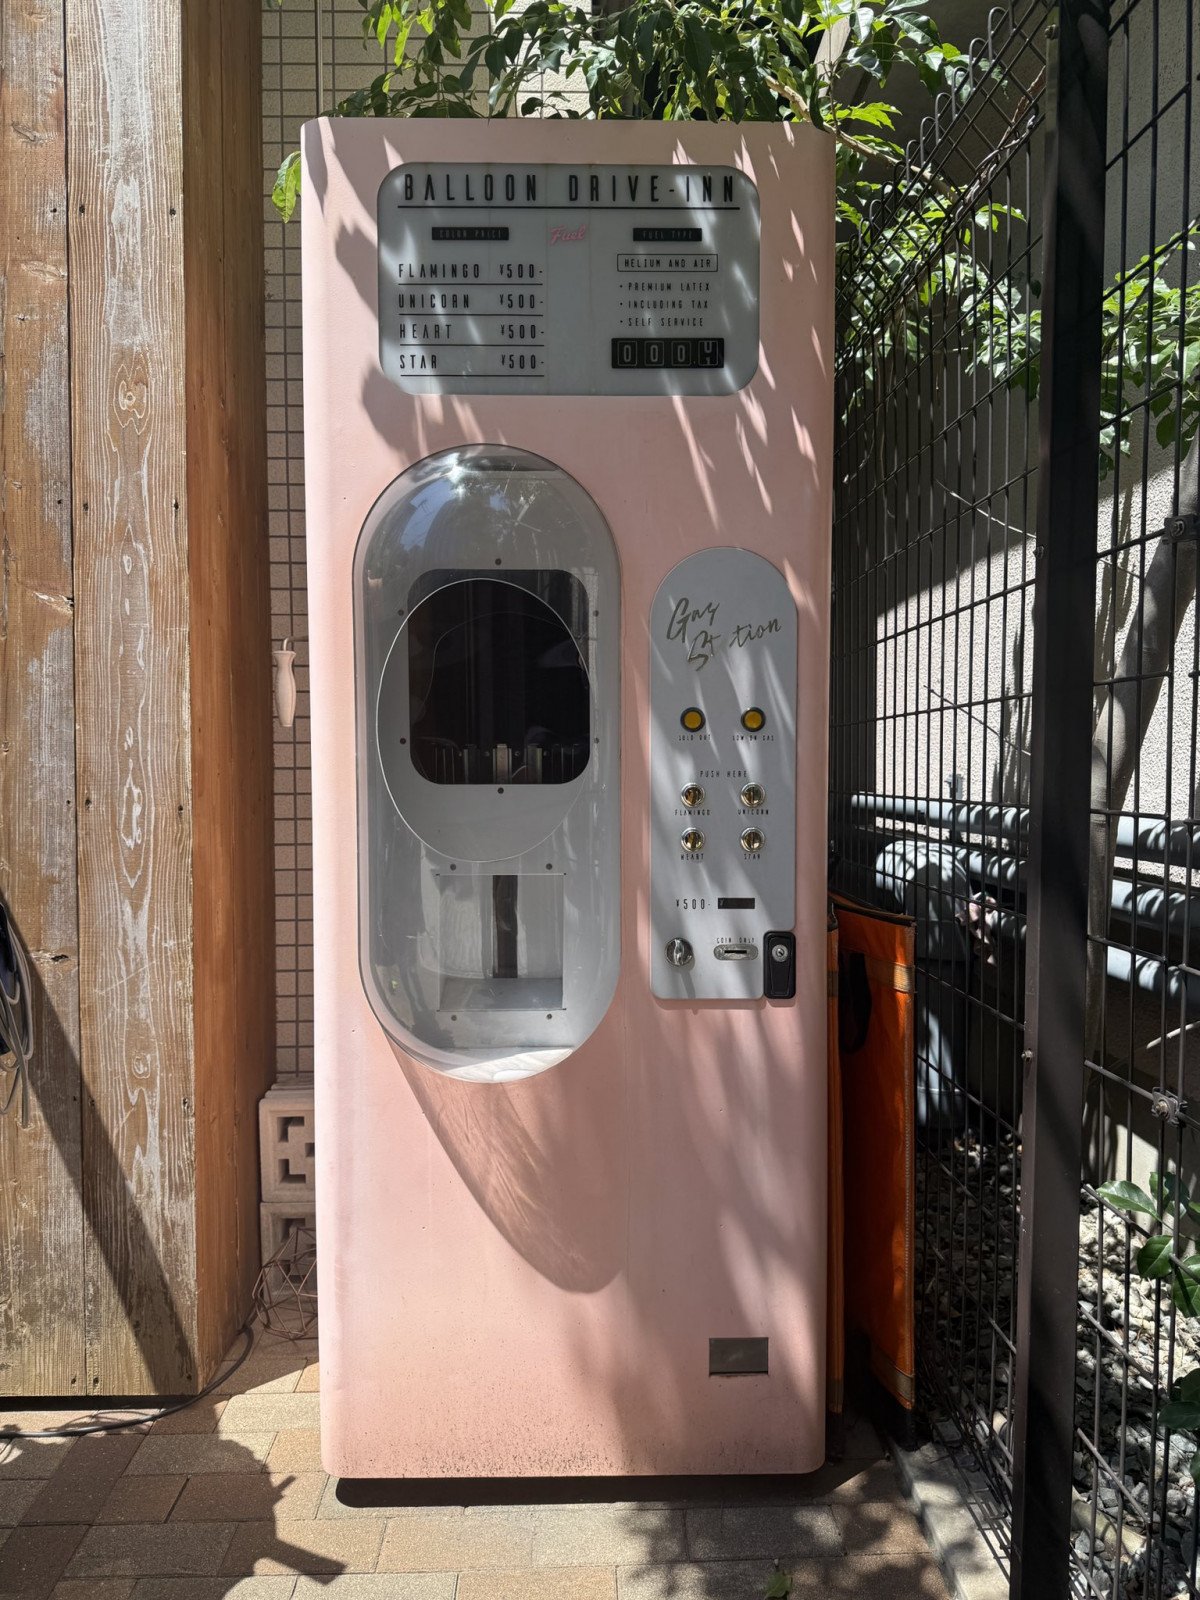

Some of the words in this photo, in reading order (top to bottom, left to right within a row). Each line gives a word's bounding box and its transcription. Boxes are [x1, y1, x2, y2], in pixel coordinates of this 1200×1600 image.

[404, 174, 537, 201] BALLOON
[569, 175, 734, 202] DRIVE-INN
[549, 223, 587, 245] Fuel
[642, 230, 664, 240] FUEL
[671, 230, 693, 240] TYPE
[624, 258, 661, 268] HELIUM
[668, 258, 686, 268] AND
[693, 258, 711, 268] AIR
[398, 263, 480, 278] FLAMINGO
[628, 282, 672, 291] PREMIUM
[680, 282, 710, 291] LATEX
[398, 293, 470, 308] UNICORN
[628, 300, 683, 309] INCLUDING
[691, 300, 708, 309] TAX
[628, 317, 652, 327] SELF
[660, 317, 704, 327] SERVICE
[399, 324, 452, 339] HEART
[399, 354, 437, 369] STAR
[666, 597, 720, 643] Gas
[699, 770, 720, 778] PUSH
[726, 770, 747, 778] HERE
[674, 808, 711, 816] FLAMINGO
[737, 808, 769, 816] UNICORN
